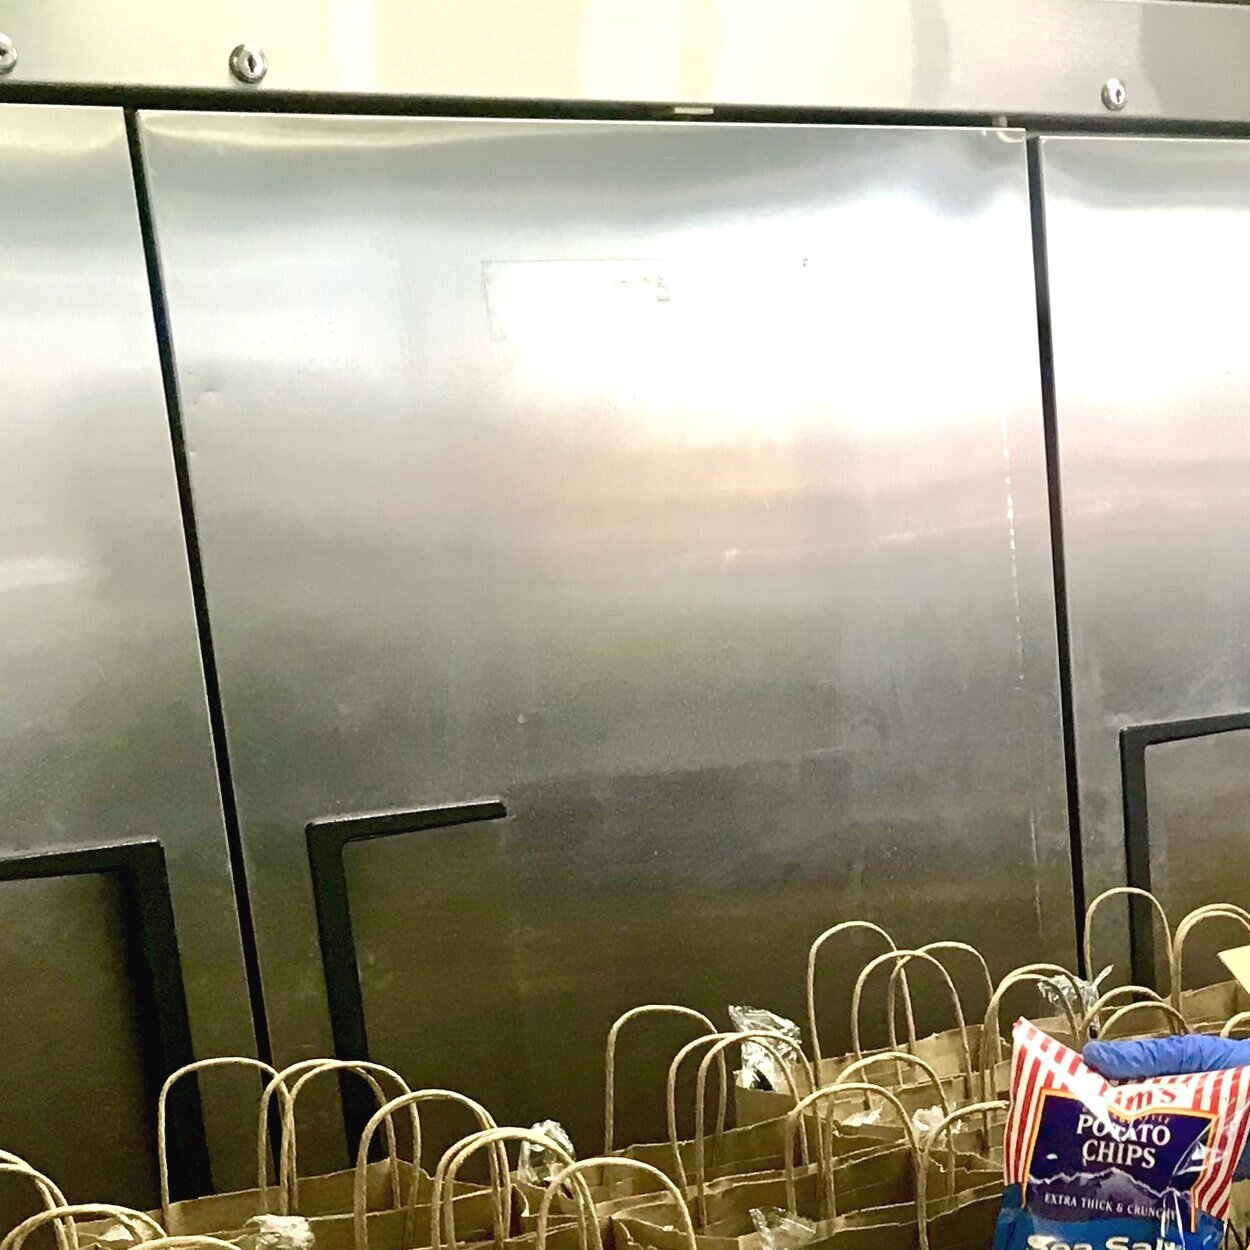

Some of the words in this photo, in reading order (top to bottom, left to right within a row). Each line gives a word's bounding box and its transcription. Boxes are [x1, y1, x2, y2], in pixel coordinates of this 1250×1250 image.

[1076, 1114, 1171, 1146] POTATO
[1082, 1139, 1156, 1169] CHIPS
[1044, 1192, 1077, 1208] EXTRA
[1081, 1198, 1113, 1212] THICK
[1116, 1203, 1123, 1213] &
[1127, 1204, 1176, 1220] CRUNCHY
